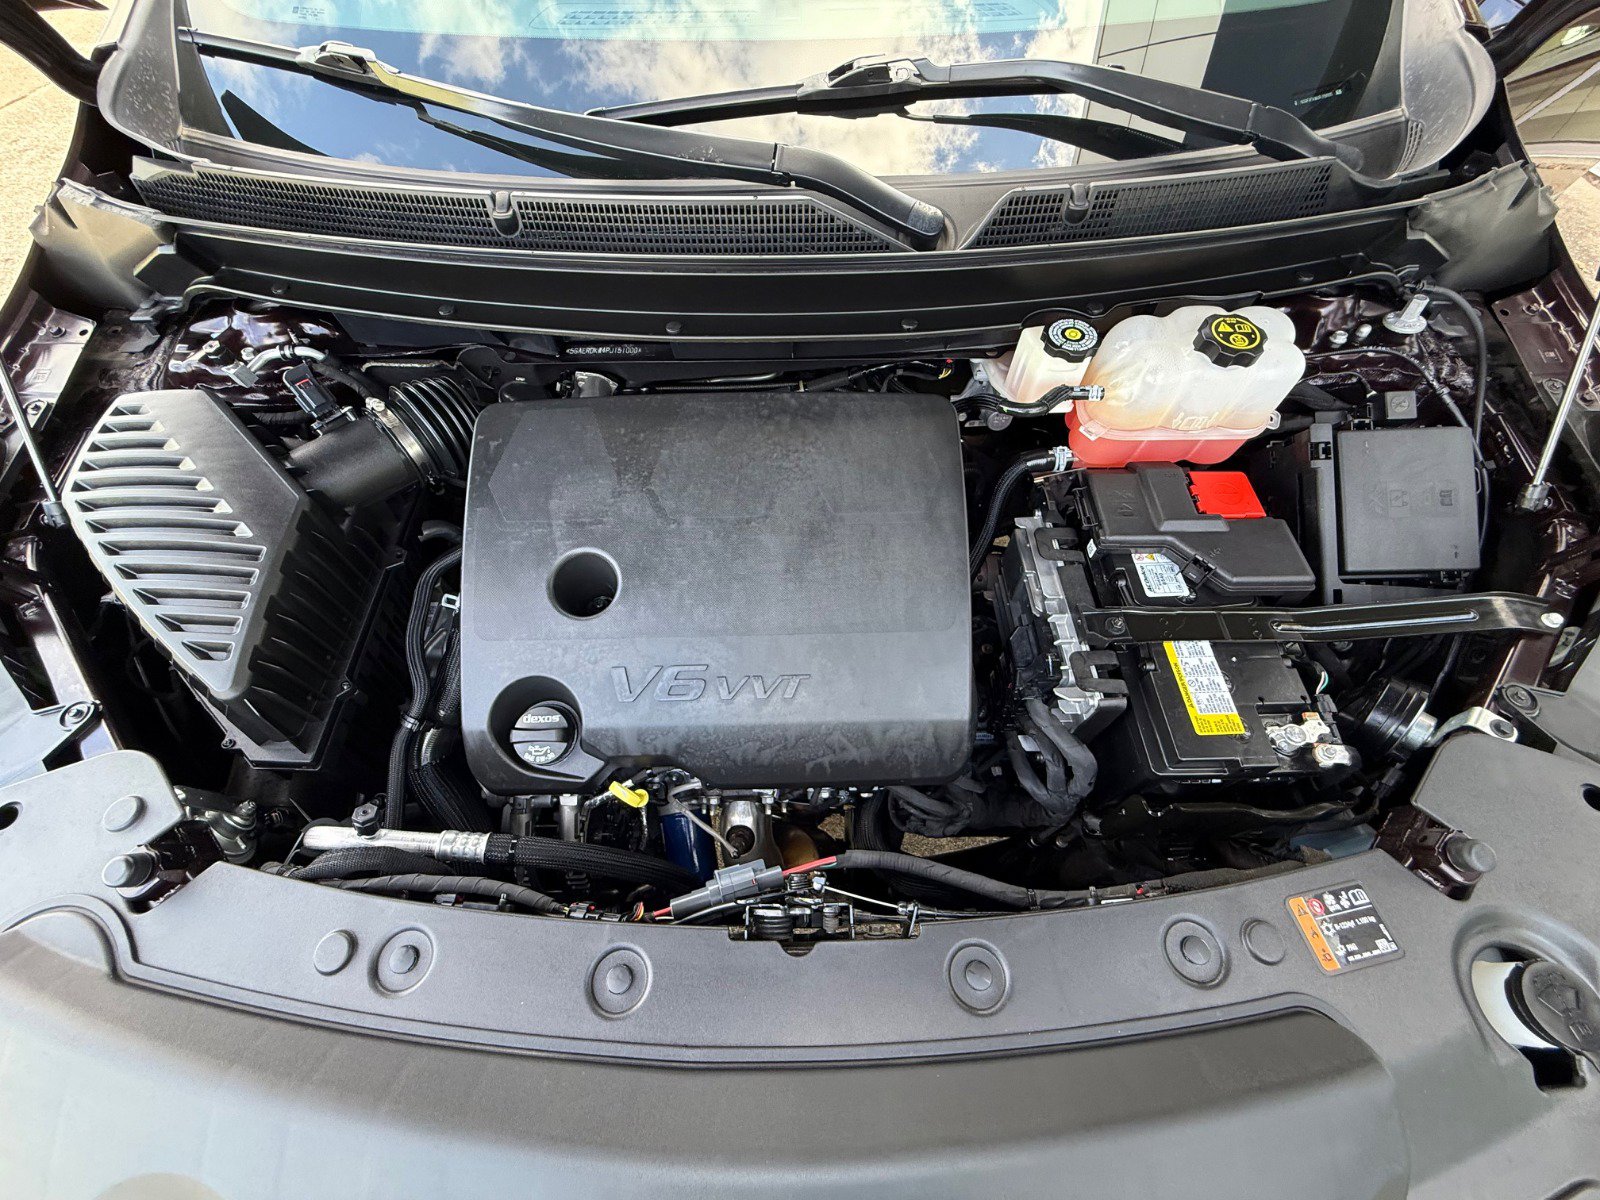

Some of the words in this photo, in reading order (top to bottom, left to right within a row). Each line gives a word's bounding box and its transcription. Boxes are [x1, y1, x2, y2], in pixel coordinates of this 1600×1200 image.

[610, 664, 708, 702] V6
[717, 674, 811, 700] VVT
[522, 713, 561, 724] dexos
